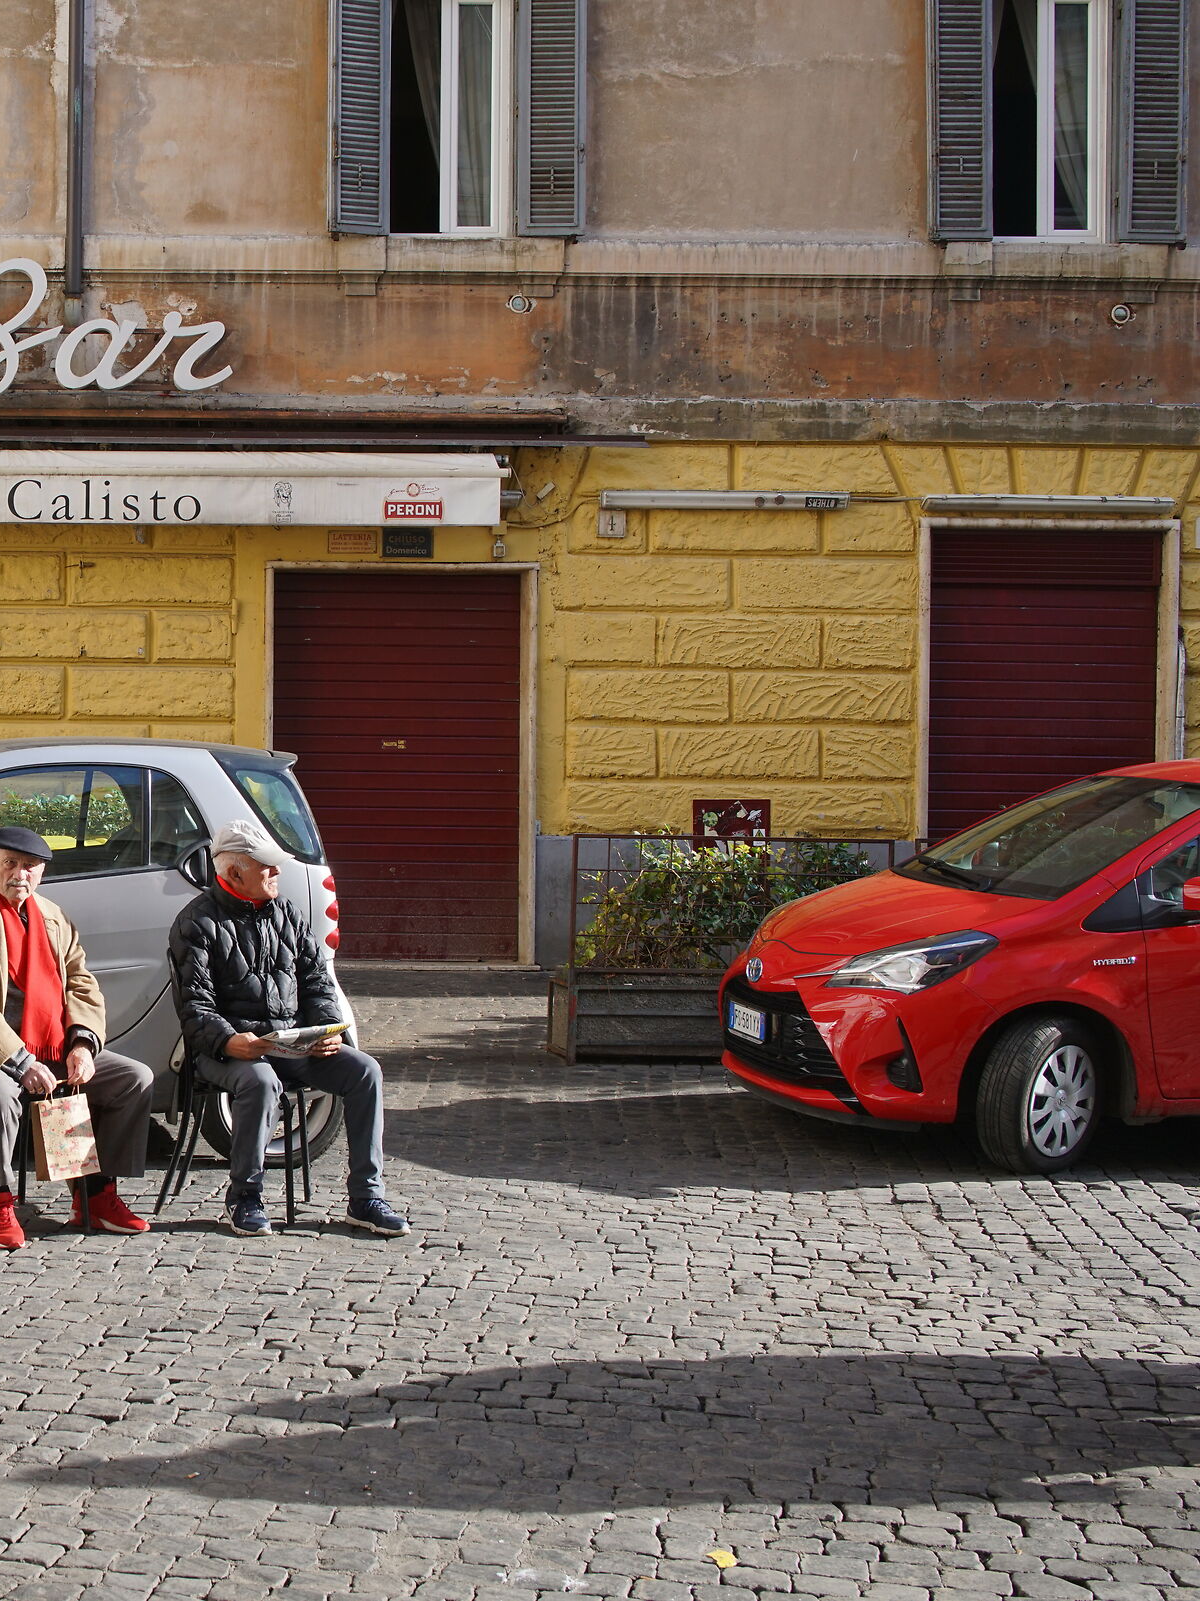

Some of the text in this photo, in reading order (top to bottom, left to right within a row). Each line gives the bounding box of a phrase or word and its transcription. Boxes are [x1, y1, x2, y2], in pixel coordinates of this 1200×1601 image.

[387, 504, 440, 516] PERONI
[608, 515, 617, 532] 4
[388, 535, 426, 544] CHIUSO
[385, 545, 427, 555] Domenica
